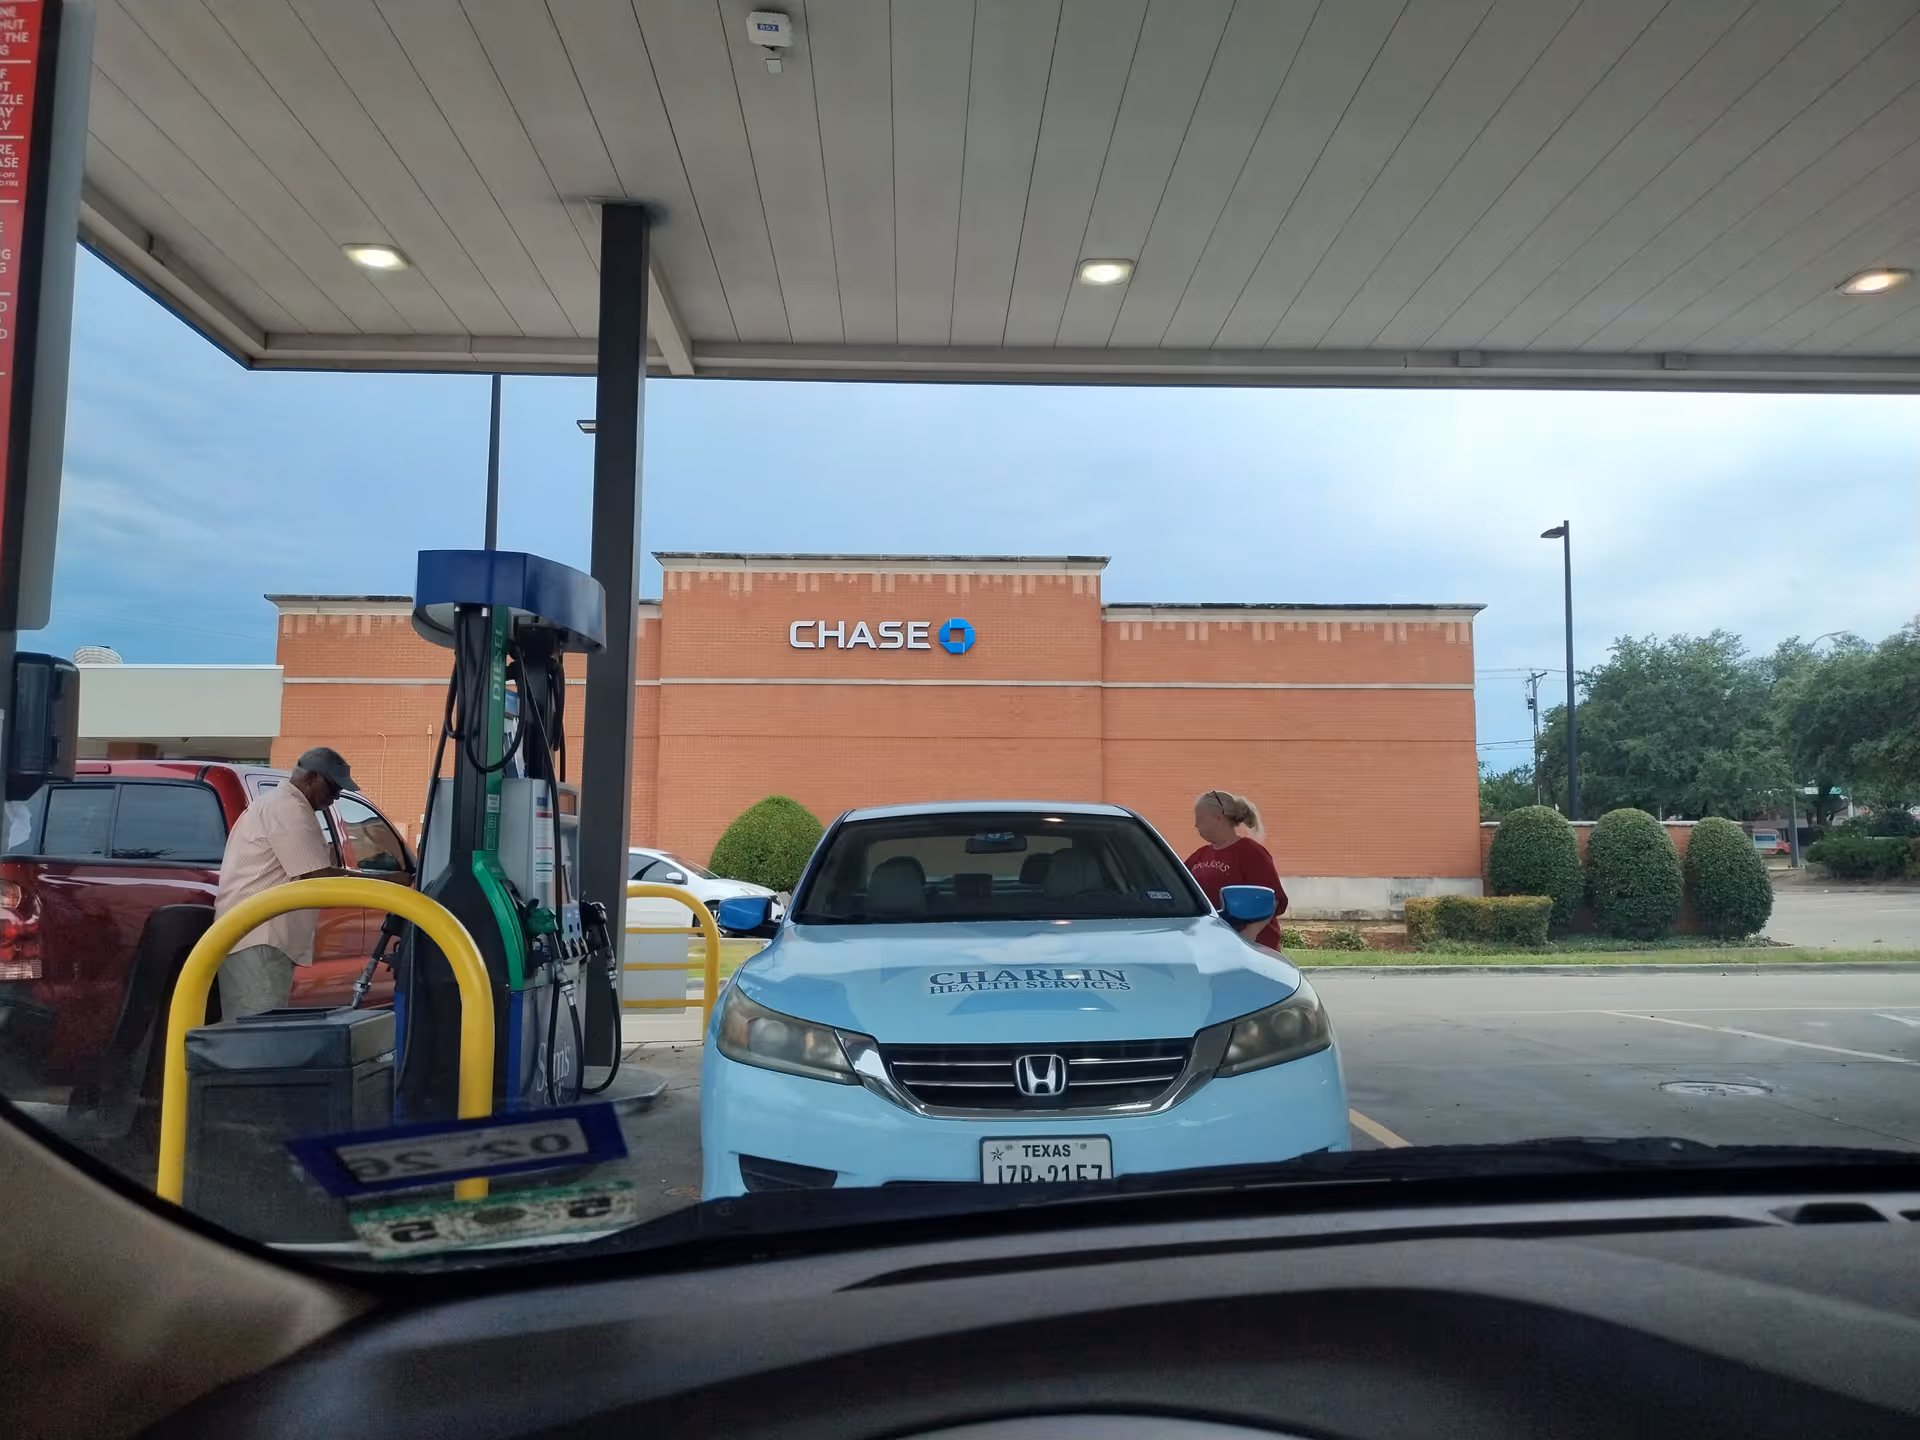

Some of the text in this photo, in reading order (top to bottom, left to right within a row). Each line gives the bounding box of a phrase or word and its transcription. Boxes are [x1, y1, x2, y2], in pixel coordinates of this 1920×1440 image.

[4, 32, 29, 43] THE
[789, 620, 932, 649] CHASE
[492, 627, 503, 701] DIESEL
[929, 968, 1126, 986] CHARLIN
[929, 980, 1132, 994] HEALTH SERVICES
[1022, 1144, 1071, 1157] TEXAS
